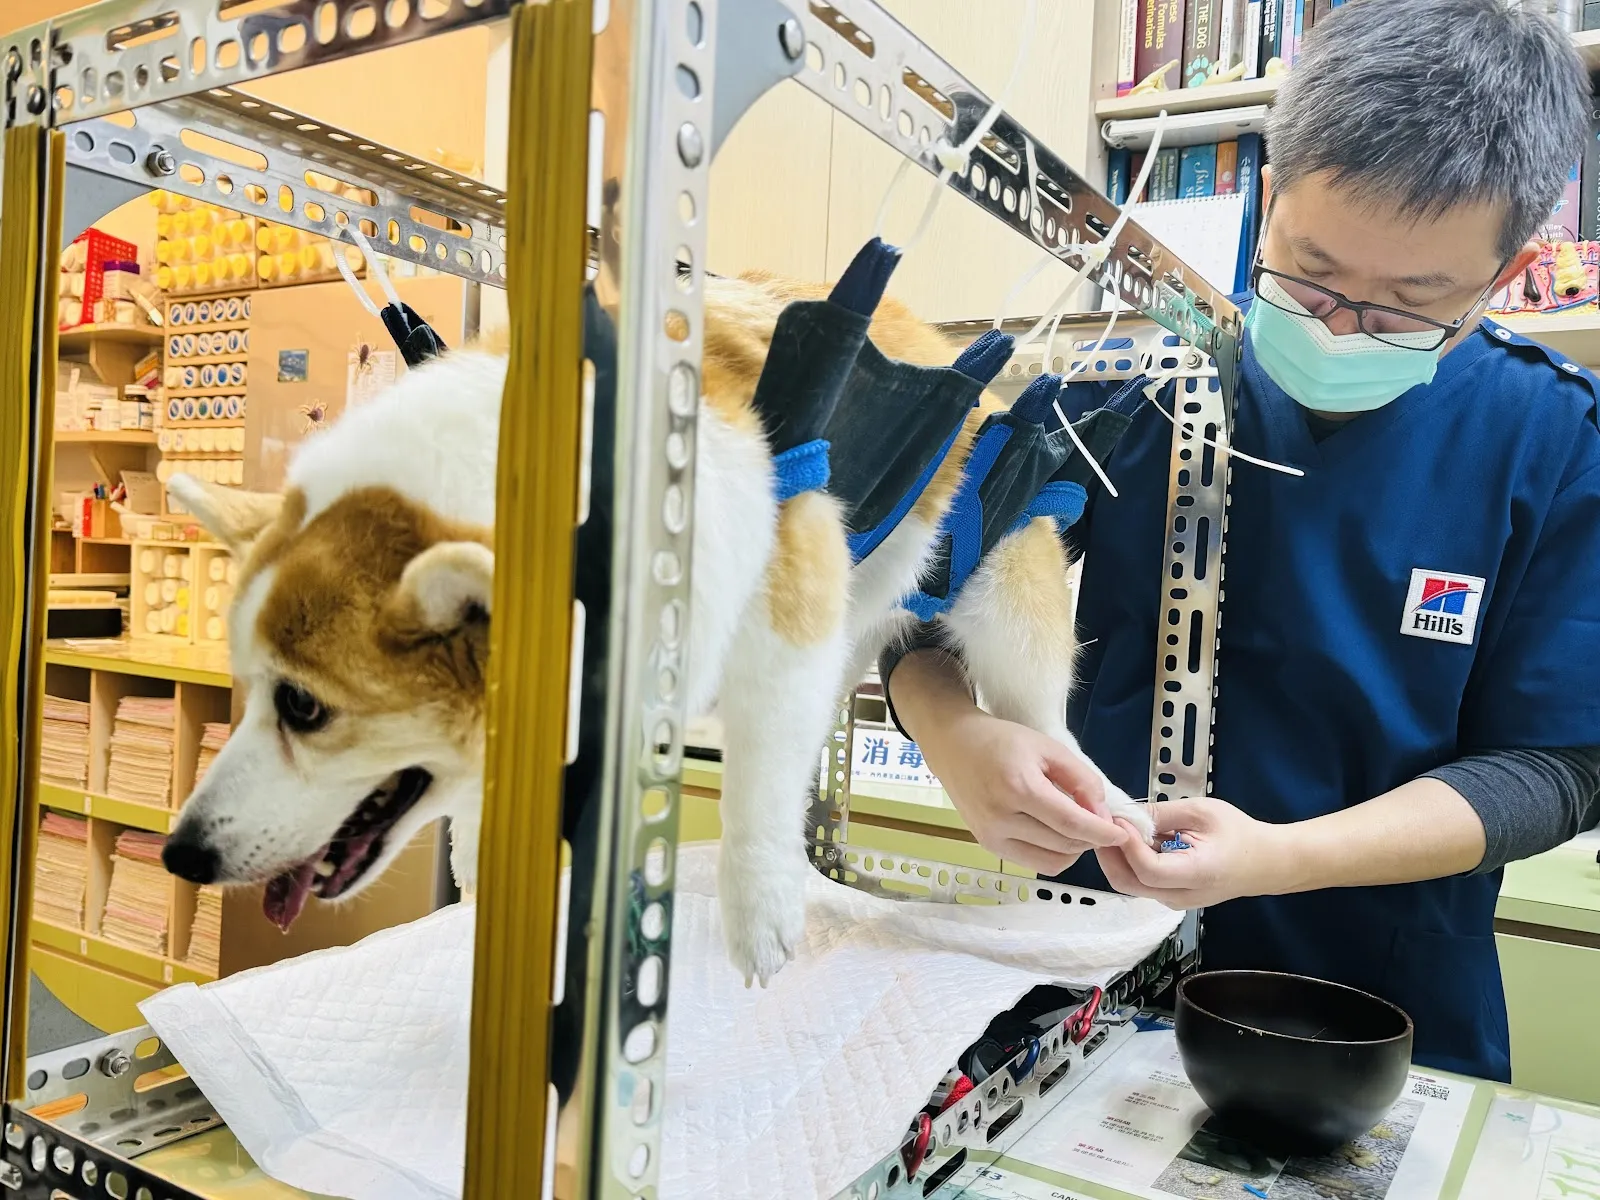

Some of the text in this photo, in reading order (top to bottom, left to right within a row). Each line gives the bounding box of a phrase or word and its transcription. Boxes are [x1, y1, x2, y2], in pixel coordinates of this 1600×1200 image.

[1156, 3, 1168, 50] Formulas
[1196, 3, 1210, 49] THE DOG
[1412, 612, 1463, 636] Hill's
